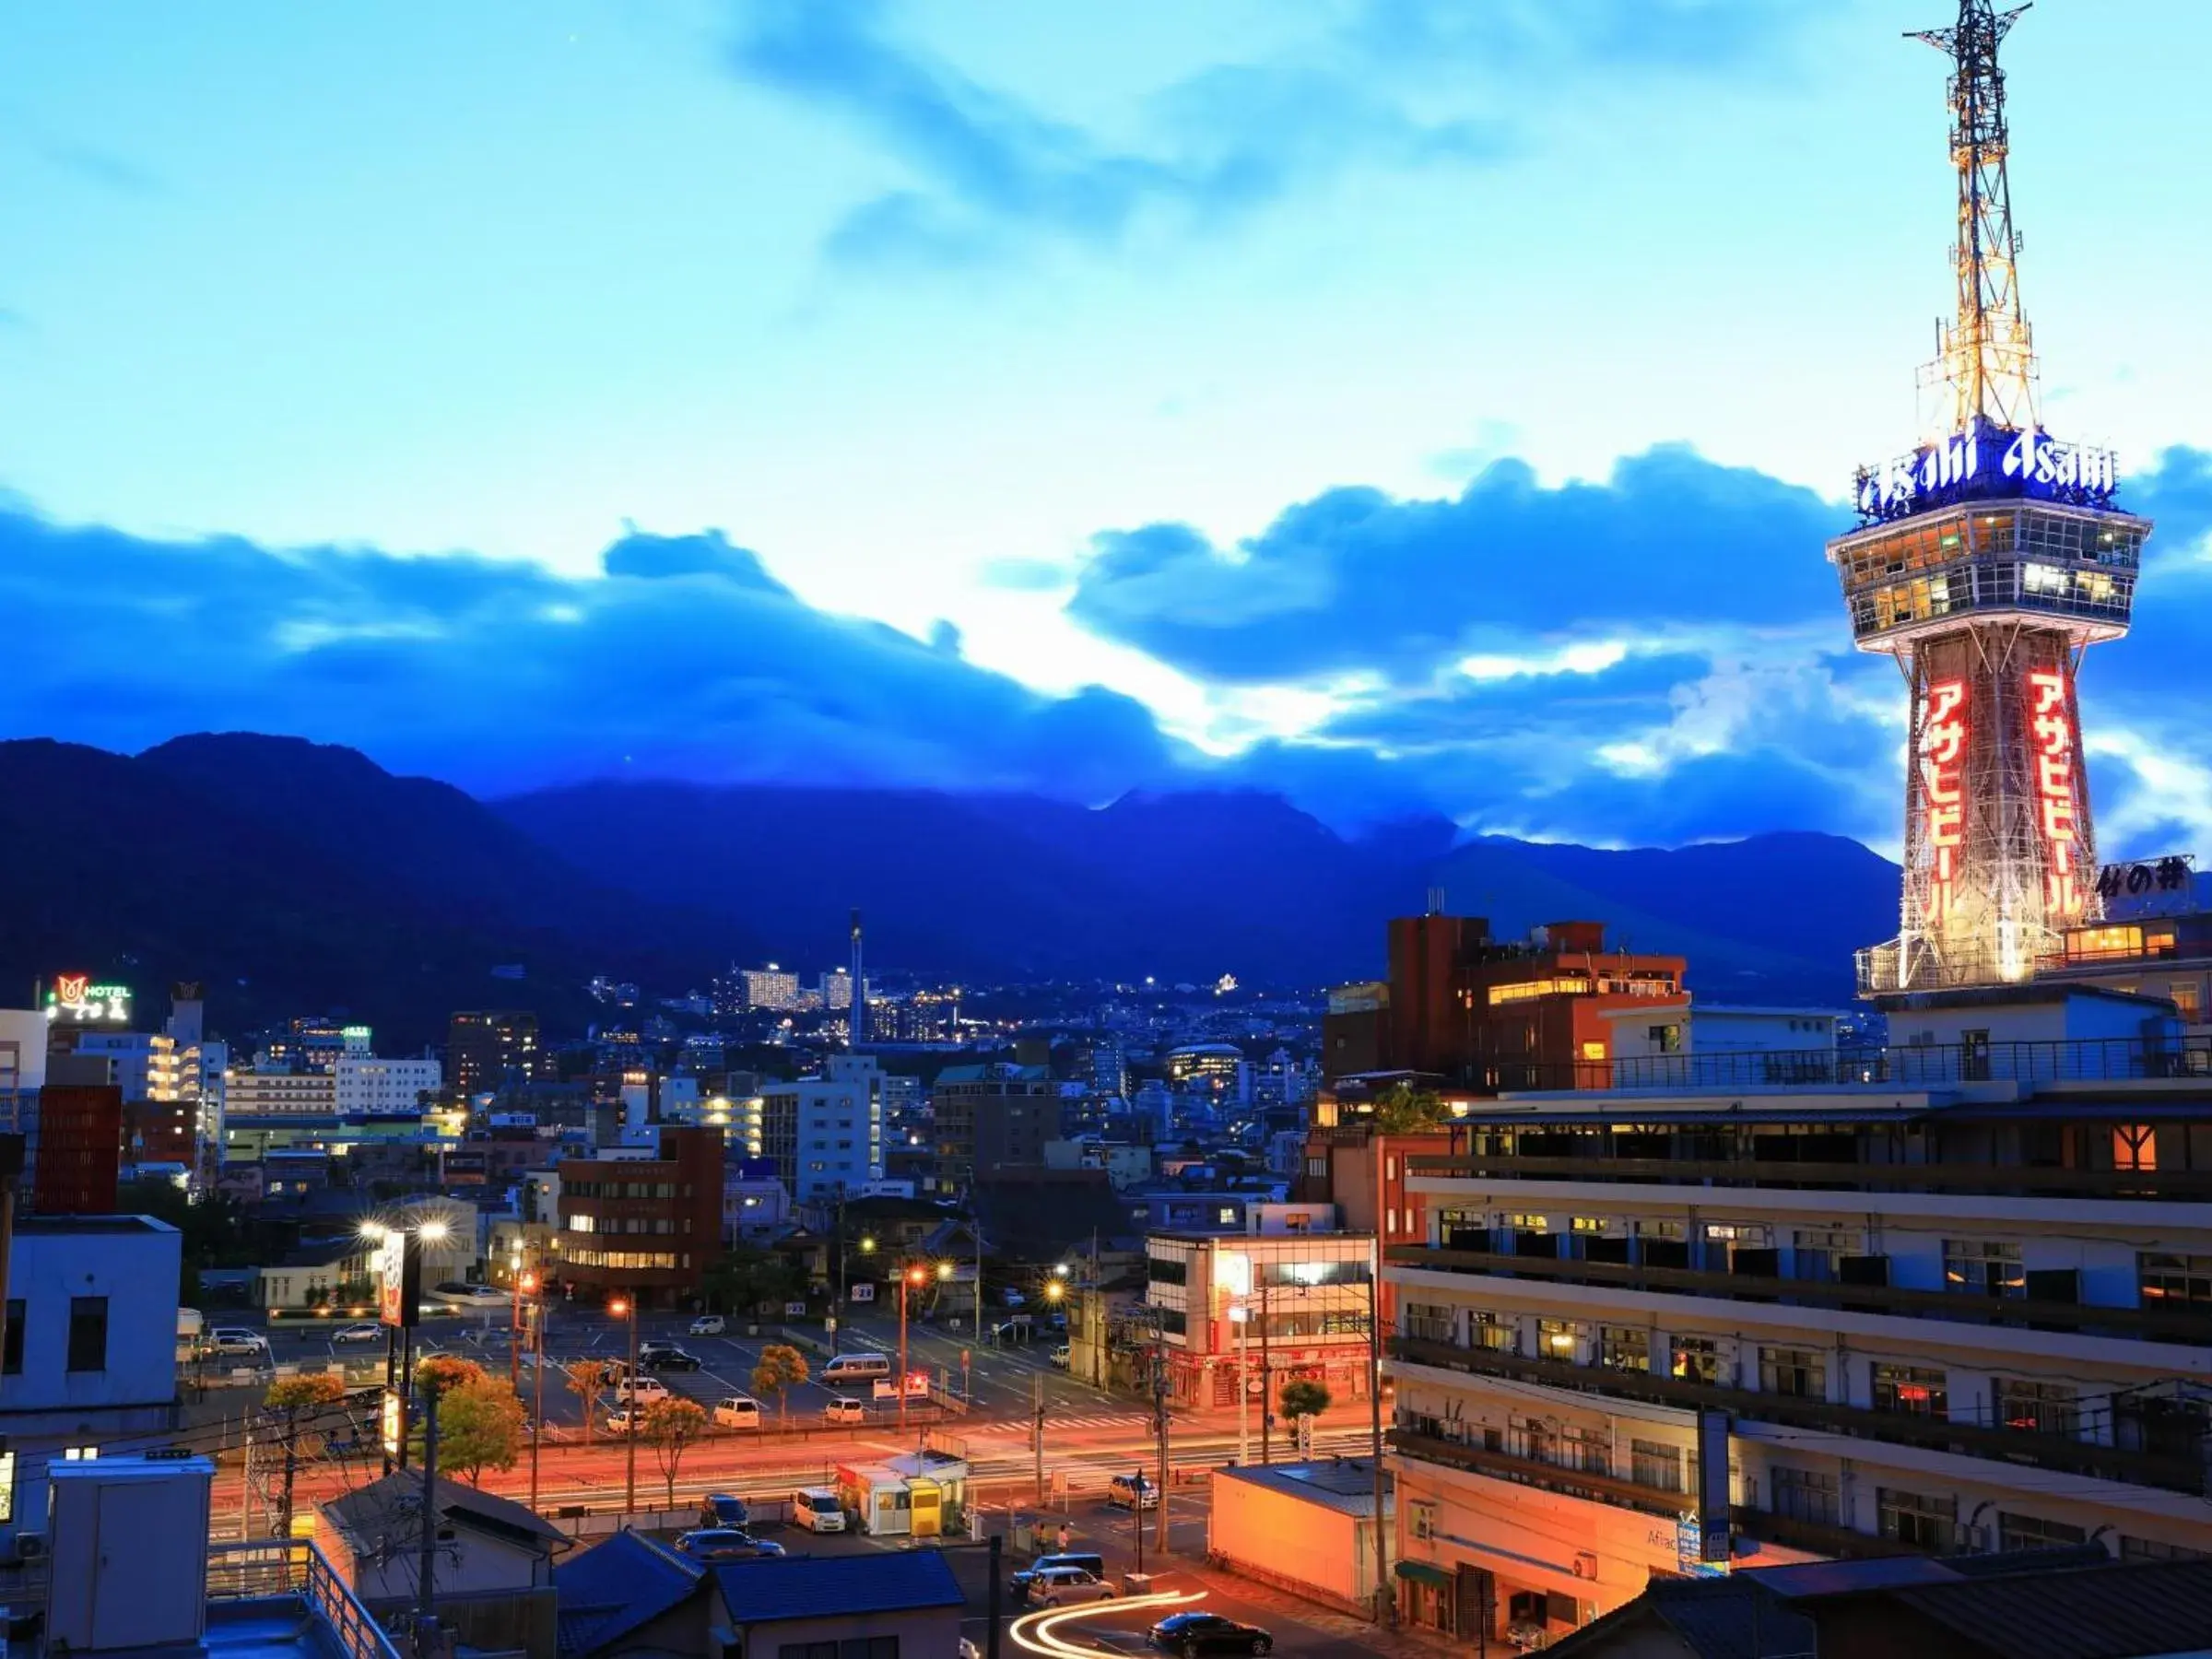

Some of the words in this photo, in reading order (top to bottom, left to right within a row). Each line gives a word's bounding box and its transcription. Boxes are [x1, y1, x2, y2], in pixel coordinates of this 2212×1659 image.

[1860, 418, 1978, 512] Asahi
[2002, 421, 2114, 494] Asahi
[1926, 682, 1965, 924] アサヒビール
[2030, 673, 2083, 915] アサヒビール
[84, 985, 132, 997] HOTEL
